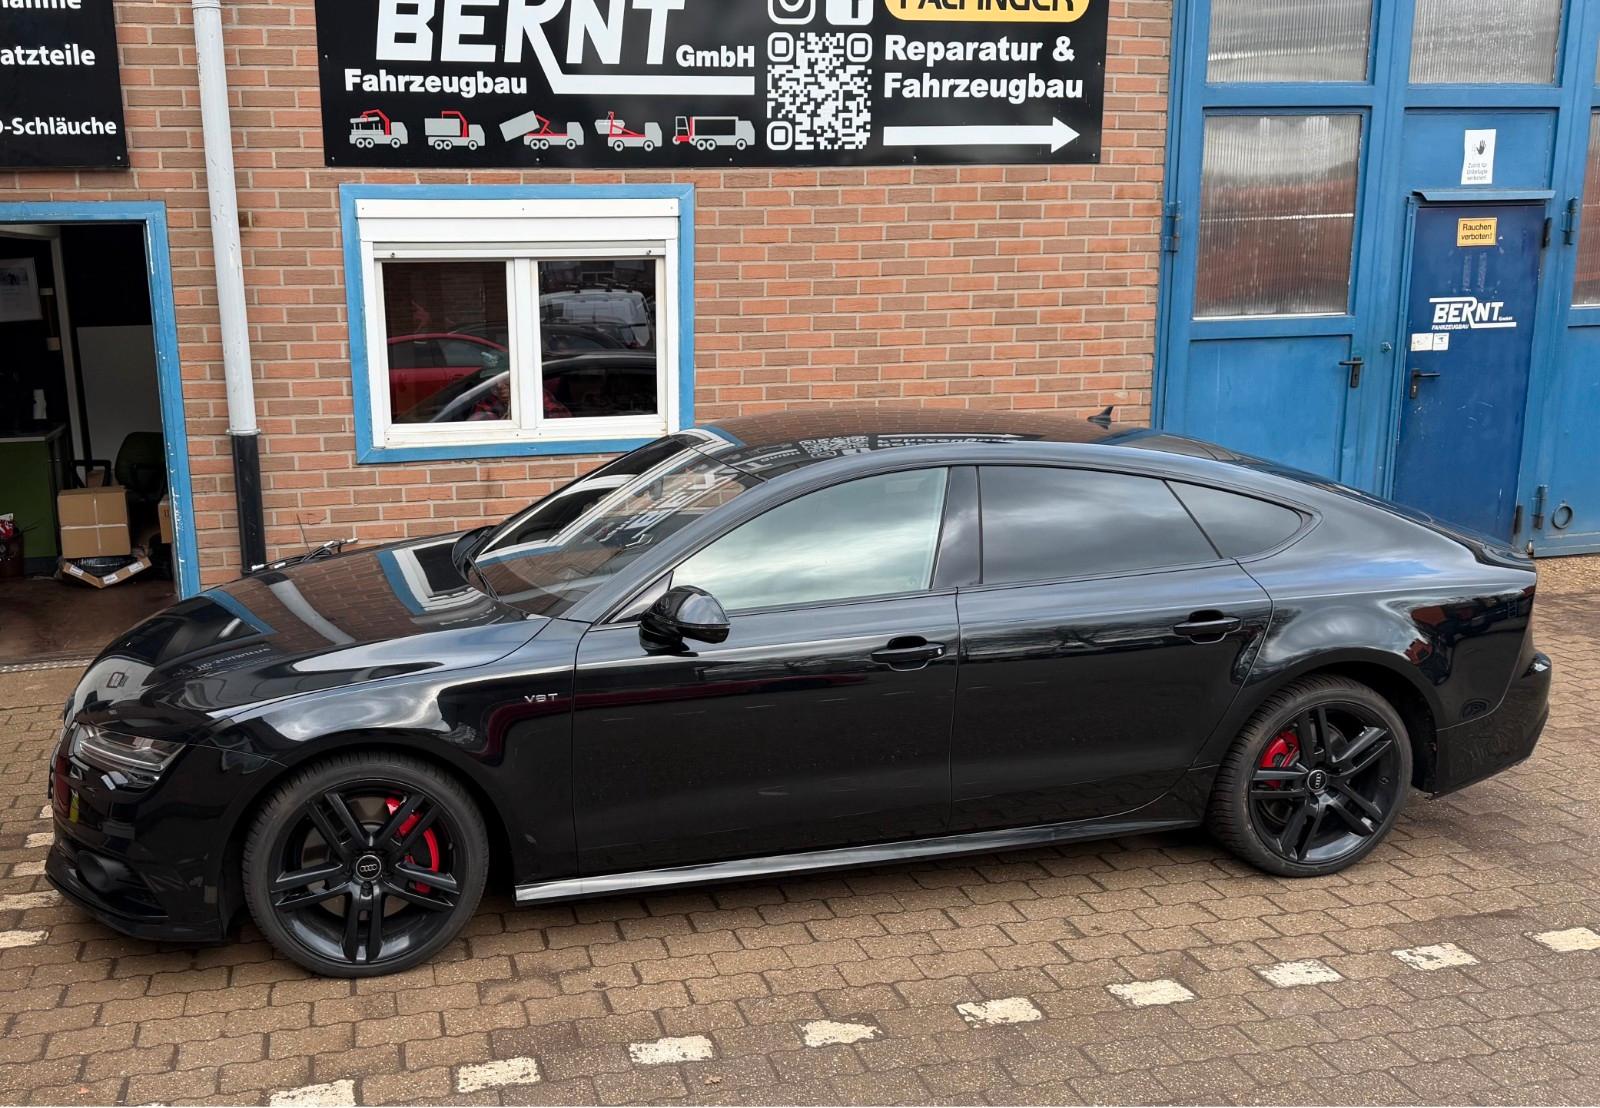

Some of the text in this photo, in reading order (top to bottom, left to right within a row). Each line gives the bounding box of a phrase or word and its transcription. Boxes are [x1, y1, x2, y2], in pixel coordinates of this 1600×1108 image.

[376, 0, 755, 68] BERNT GmbH
[0, 43, 96, 66] atzteile
[884, 34, 1076, 67] Reparatur &
[344, 67, 528, 98] Fahrzeugbau
[884, 72, 1084, 104] Fahrzeugbau
[0, 116, 117, 135] -Schläuche
[1461, 232, 1493, 240] verboten!
[1462, 223, 1492, 231] Rauchen
[1431, 297, 1505, 325] BERNT
[524, 692, 559, 703] V8T
